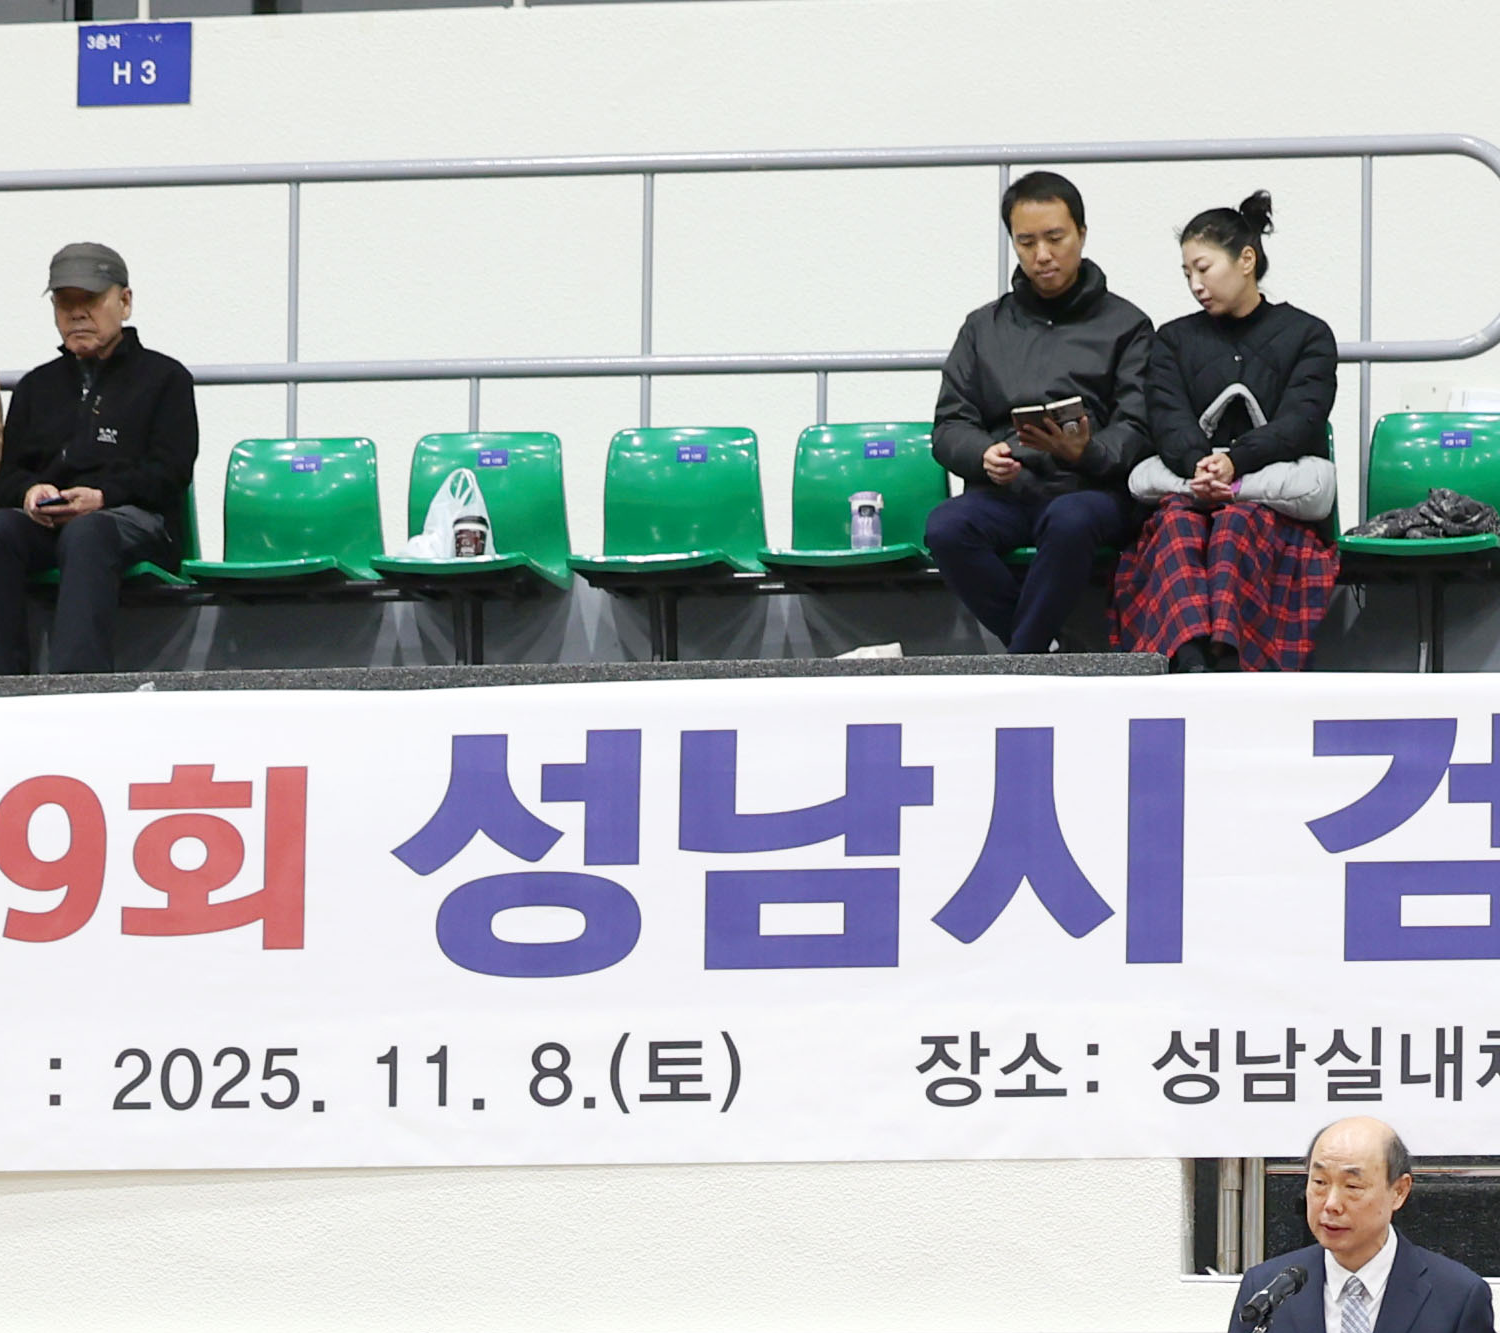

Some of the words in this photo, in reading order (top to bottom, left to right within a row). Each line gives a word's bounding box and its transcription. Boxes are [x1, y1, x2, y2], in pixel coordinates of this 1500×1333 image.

[113, 61, 131, 85] H
[140, 60, 157, 85] 3
[390, 718, 1185, 978] 성남시
[112, 1047, 326, 1113] 2025.
[376, 1045, 485, 1110] 11.
[528, 1031, 742, 1114] 8.(토)
[915, 1031, 1100, 1107] 장소:
